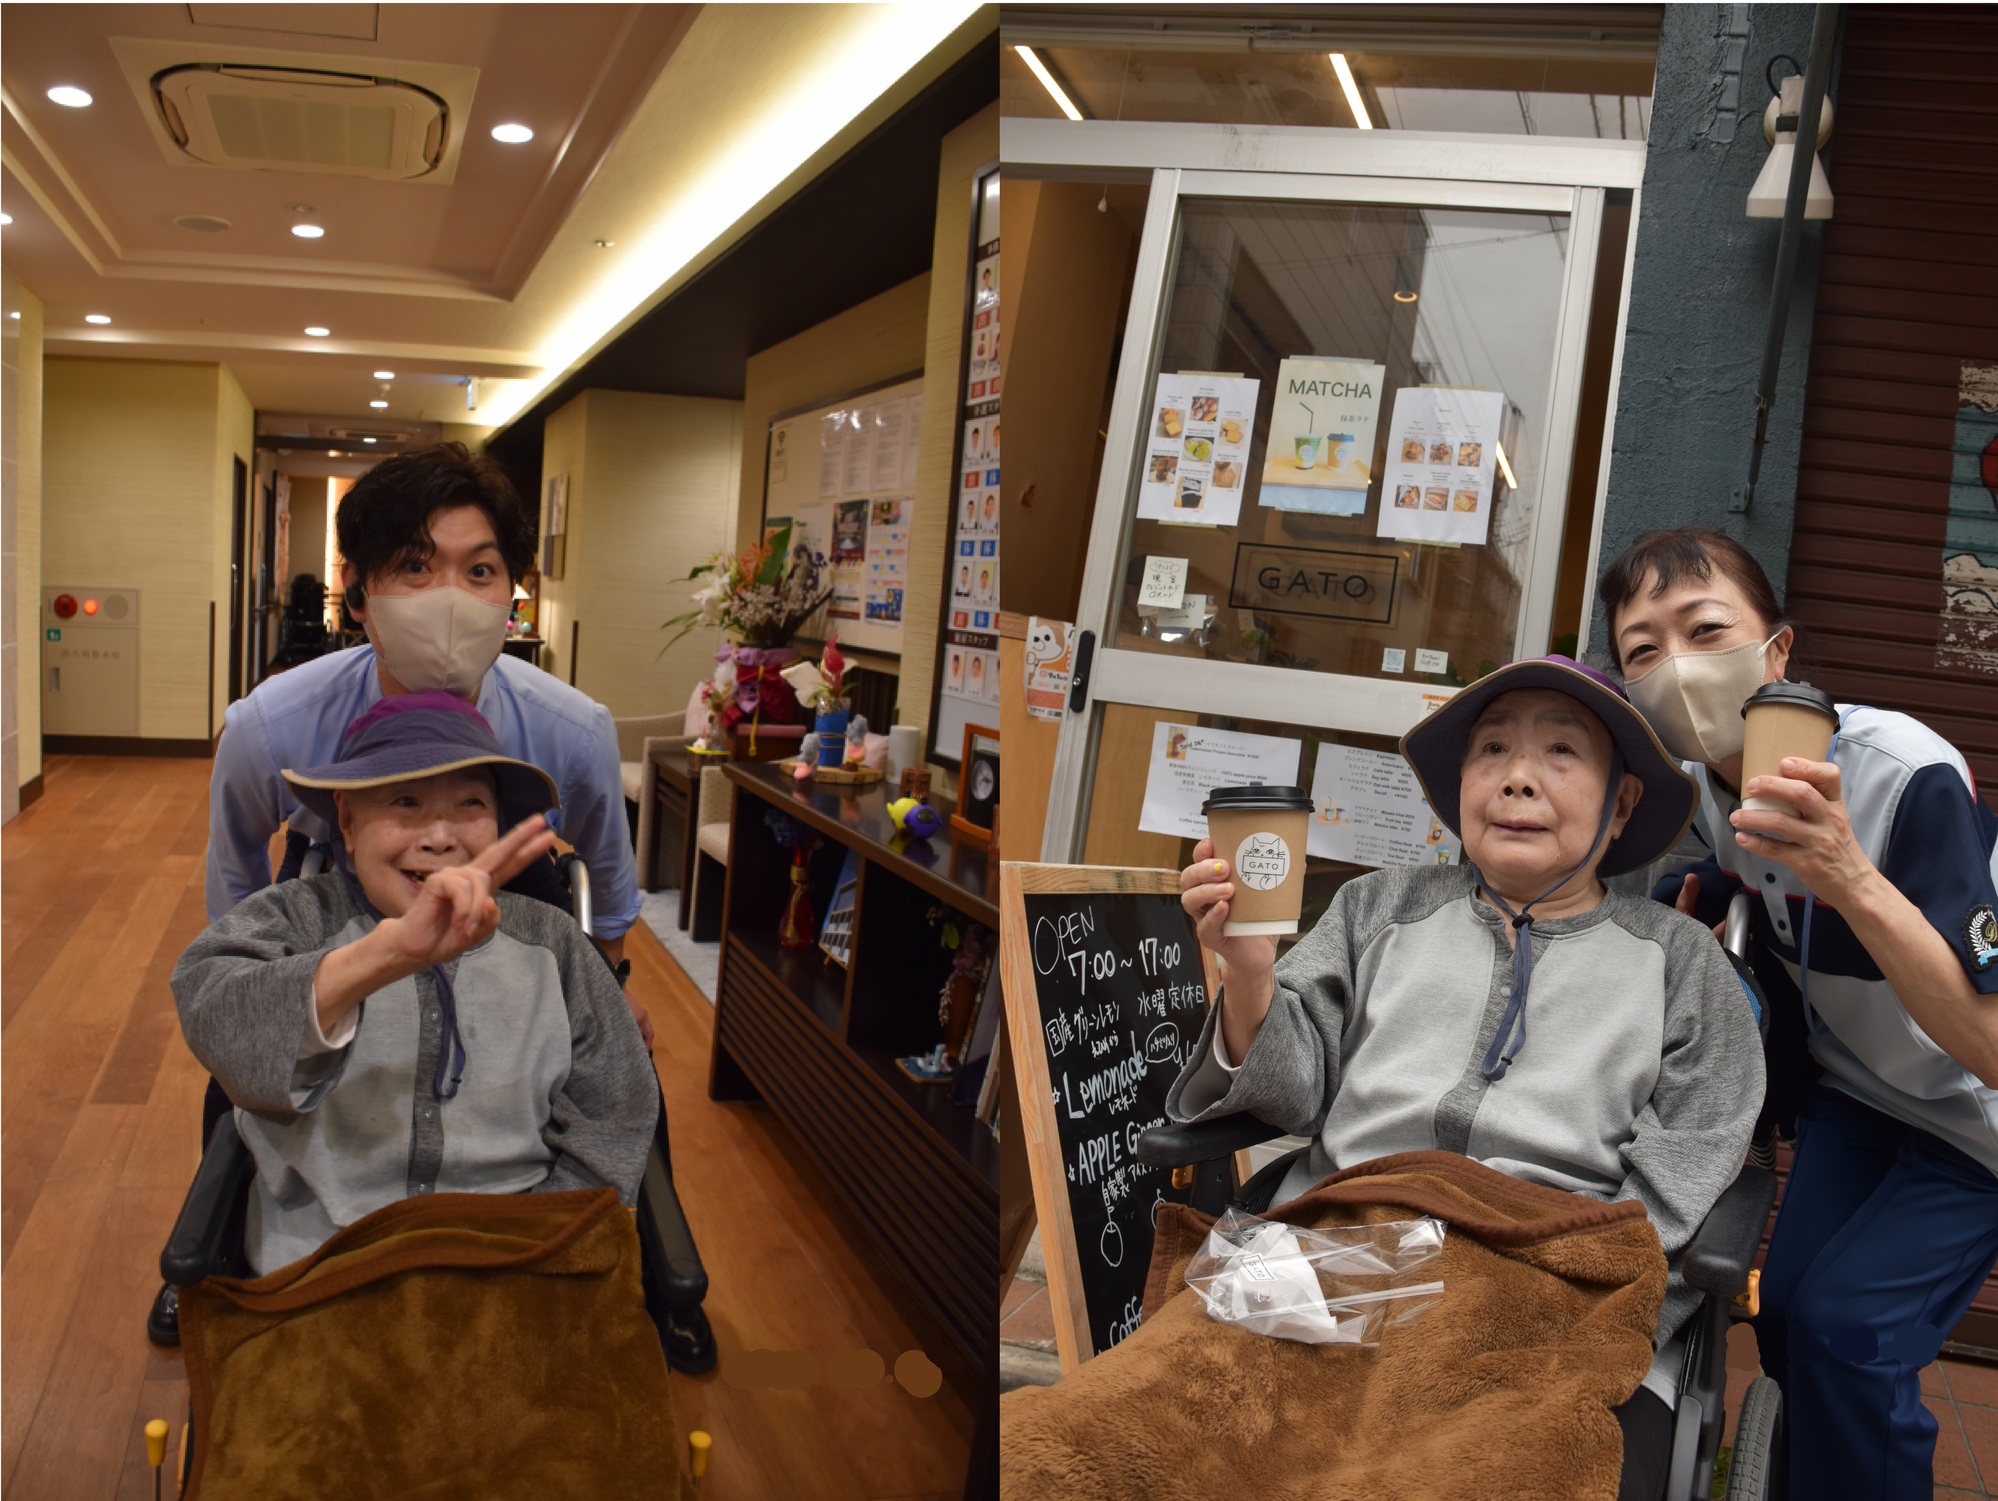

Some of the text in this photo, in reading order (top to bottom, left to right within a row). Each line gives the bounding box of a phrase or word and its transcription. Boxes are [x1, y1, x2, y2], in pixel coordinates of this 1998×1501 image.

[1289, 378, 1373, 399] MATCHA
[1340, 414, 1370, 424] 抹茶ラテ
[1257, 567, 1369, 598] GATO
[1248, 859, 1279, 871] GATO
[1034, 905, 1094, 975] OPEN
[1068, 950, 1116, 996] 7:00
[1138, 937, 1181, 976] 17:00
[1137, 980, 1204, 1018] 水曜定休日
[1062, 1030, 1148, 1119] Lemonade
[1108, 1084, 1138, 1115] レモネード
[1078, 1131, 1122, 1186] APPLE
[1248, 1261, 1265, 1278] GATO
[1110, 1295, 1142, 1347] Coff
